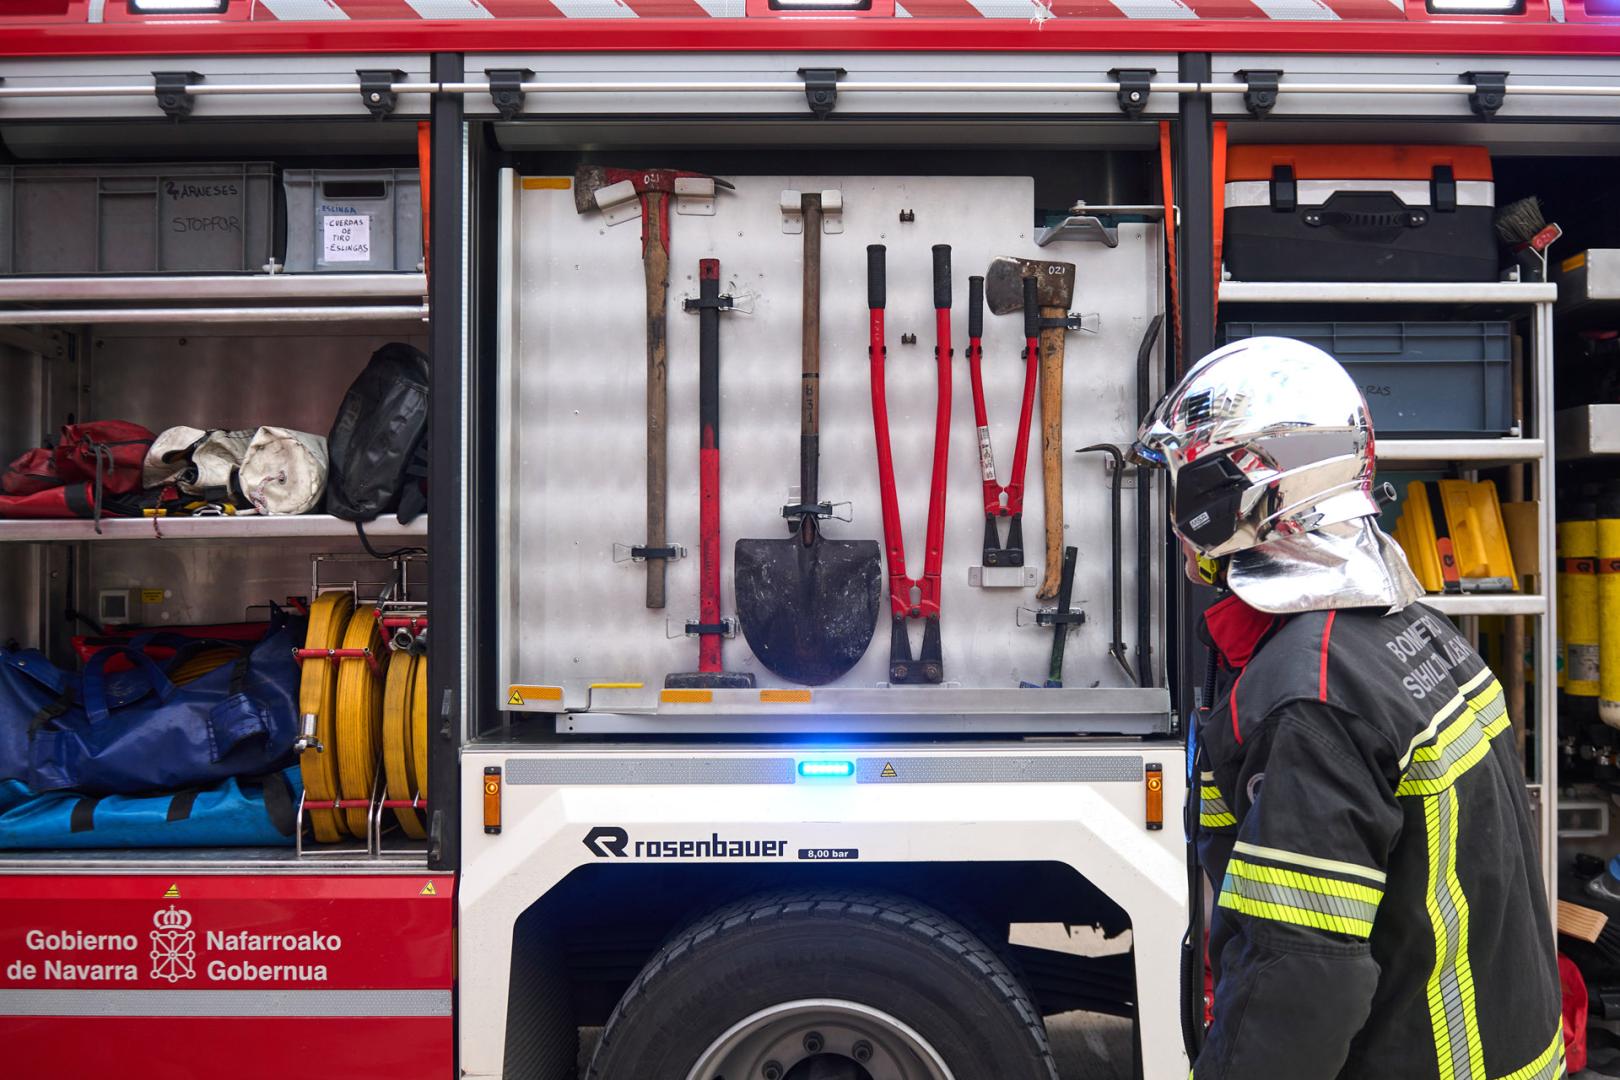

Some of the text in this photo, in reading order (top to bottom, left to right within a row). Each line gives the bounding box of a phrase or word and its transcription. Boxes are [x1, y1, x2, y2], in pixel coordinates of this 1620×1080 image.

[181, 184, 238, 199] ARNESES
[1048, 265, 1065, 275] 021
[1359, 384, 1391, 397] RAS
[635, 832, 788, 858] rosenbauer
[808, 849, 849, 859] 8,00 bar
[25, 930, 138, 951] Gobierno
[206, 930, 341, 951] Nafarroako
[6, 960, 138, 981] de Navarra
[206, 960, 328, 981] Gobernua
